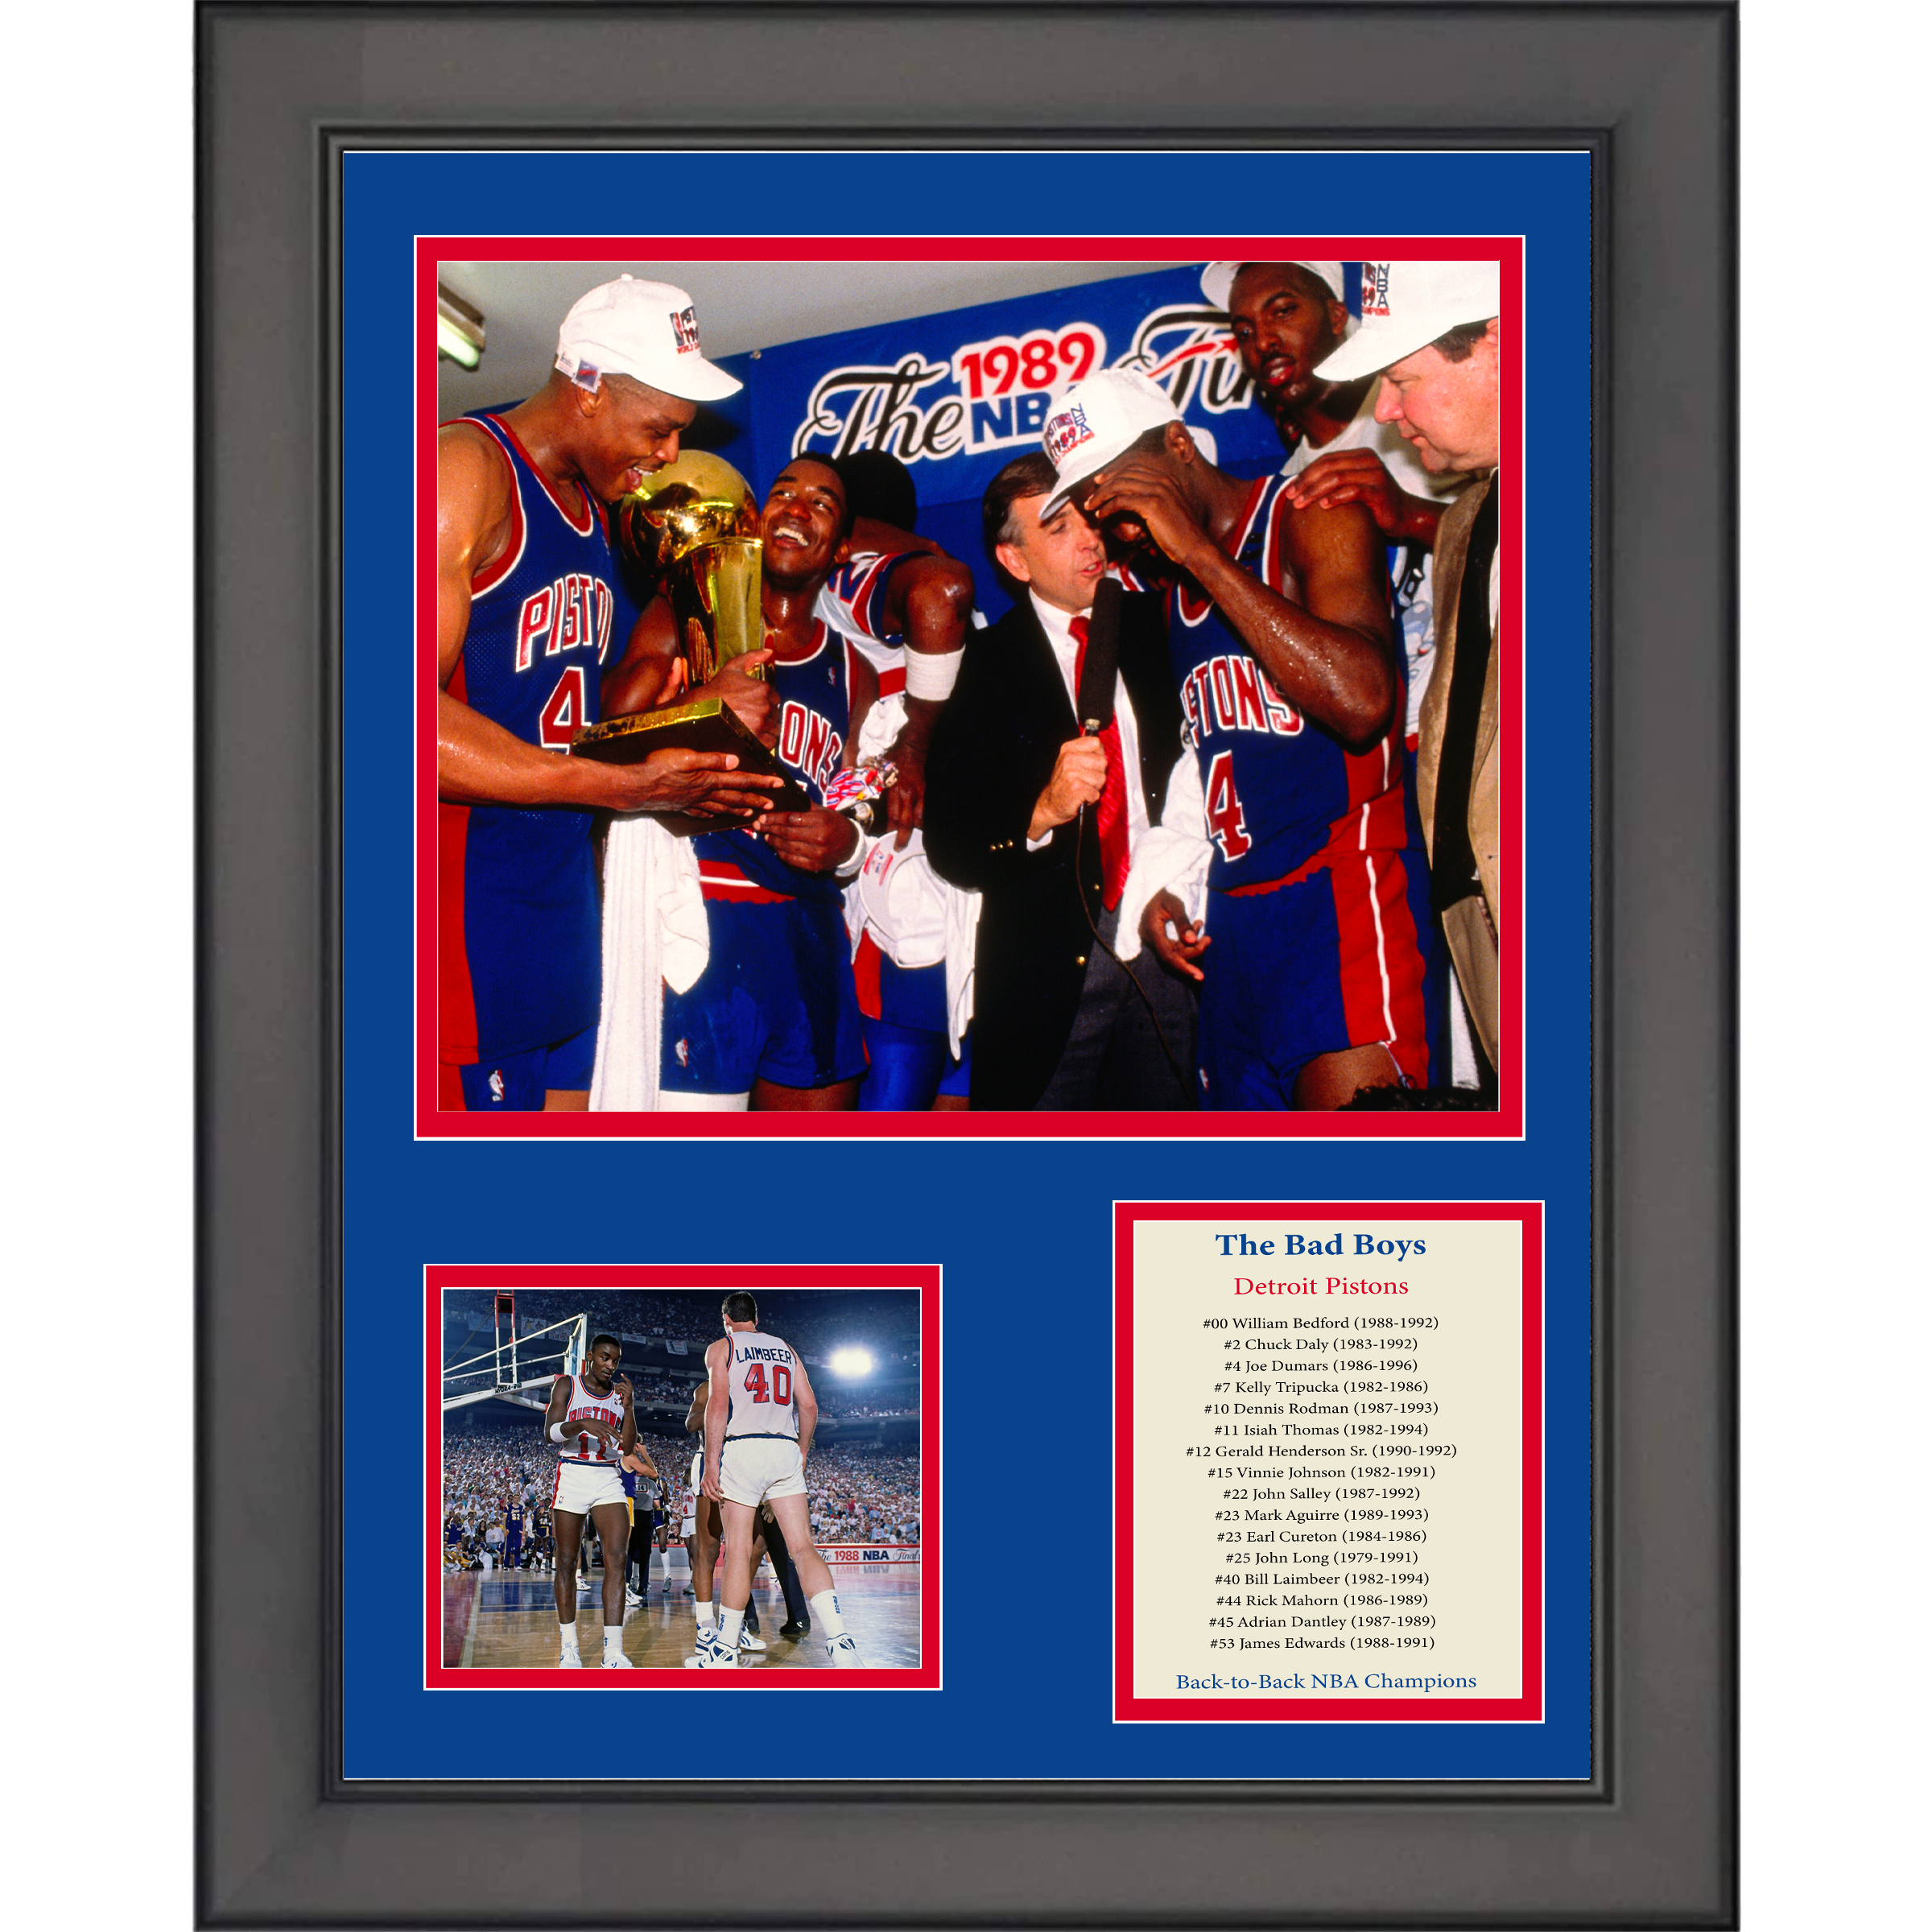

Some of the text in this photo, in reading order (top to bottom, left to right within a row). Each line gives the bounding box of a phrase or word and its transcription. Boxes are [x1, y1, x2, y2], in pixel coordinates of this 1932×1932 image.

[1376, 263, 1390, 307] NBA
[960, 332, 1096, 399] 1989
[797, 359, 964, 460] The
[970, 389, 1061, 444] NB
[539, 666, 592, 755] 4
[1205, 750, 1252, 863] 4
[1215, 1232, 1426, 1262] The Bad Boys
[1233, 1277, 1409, 1295] Detroit Pistons
[1203, 1315, 1439, 1331] #00 William Bedford (1988-1992)
[1224, 1337, 1418, 1354] #2 Chuck Daly (1983-1992)
[736, 1347, 791, 1364] LAIMBEER
[1224, 1358, 1418, 1374] #4 Joe Dumars (1986-1996)
[744, 1363, 791, 1406] 40
[1213, 1380, 1429, 1397] #7 Kelly Tripucka (1982-1986)
[1203, 1401, 1439, 1417] #10 Dennis Rodman (1987-1993)
[1214, 1422, 1429, 1438] #11 Isiah Thomas (1982-1994)
[578, 1433, 607, 1460] 11
[1186, 1443, 1457, 1459] #12 Gerald Henderson Sr. (1990-1992)
[1208, 1465, 1435, 1480] #15 Vinnie Johnson (1982-1991)
[1223, 1486, 1420, 1503] #22 John Salley (1987-1992)
[683, 1504, 688, 1514] 4
[1214, 1508, 1429, 1525] #23 Mark Aguirre (1989-1993)
[1216, 1529, 1427, 1545] #23 Earl Cureton (1984-1986)
[834, 1550, 860, 1561] 1988
[863, 1550, 890, 1560] NBA
[1225, 1550, 1418, 1567] #25 John Long (1979-1991)
[1215, 1571, 1430, 1587] #40 Bill Laimbeer (1982-1994)
[1216, 1593, 1428, 1608] #44 Rick Mahorn (1986-1989)
[1208, 1614, 1436, 1631] #45 Adrian Dantley (1987-1989)
[1209, 1636, 1435, 1651] #53 James Edwards (1988-1991)
[1175, 1672, 1477, 1693] Back-to-Back NBA Champions
